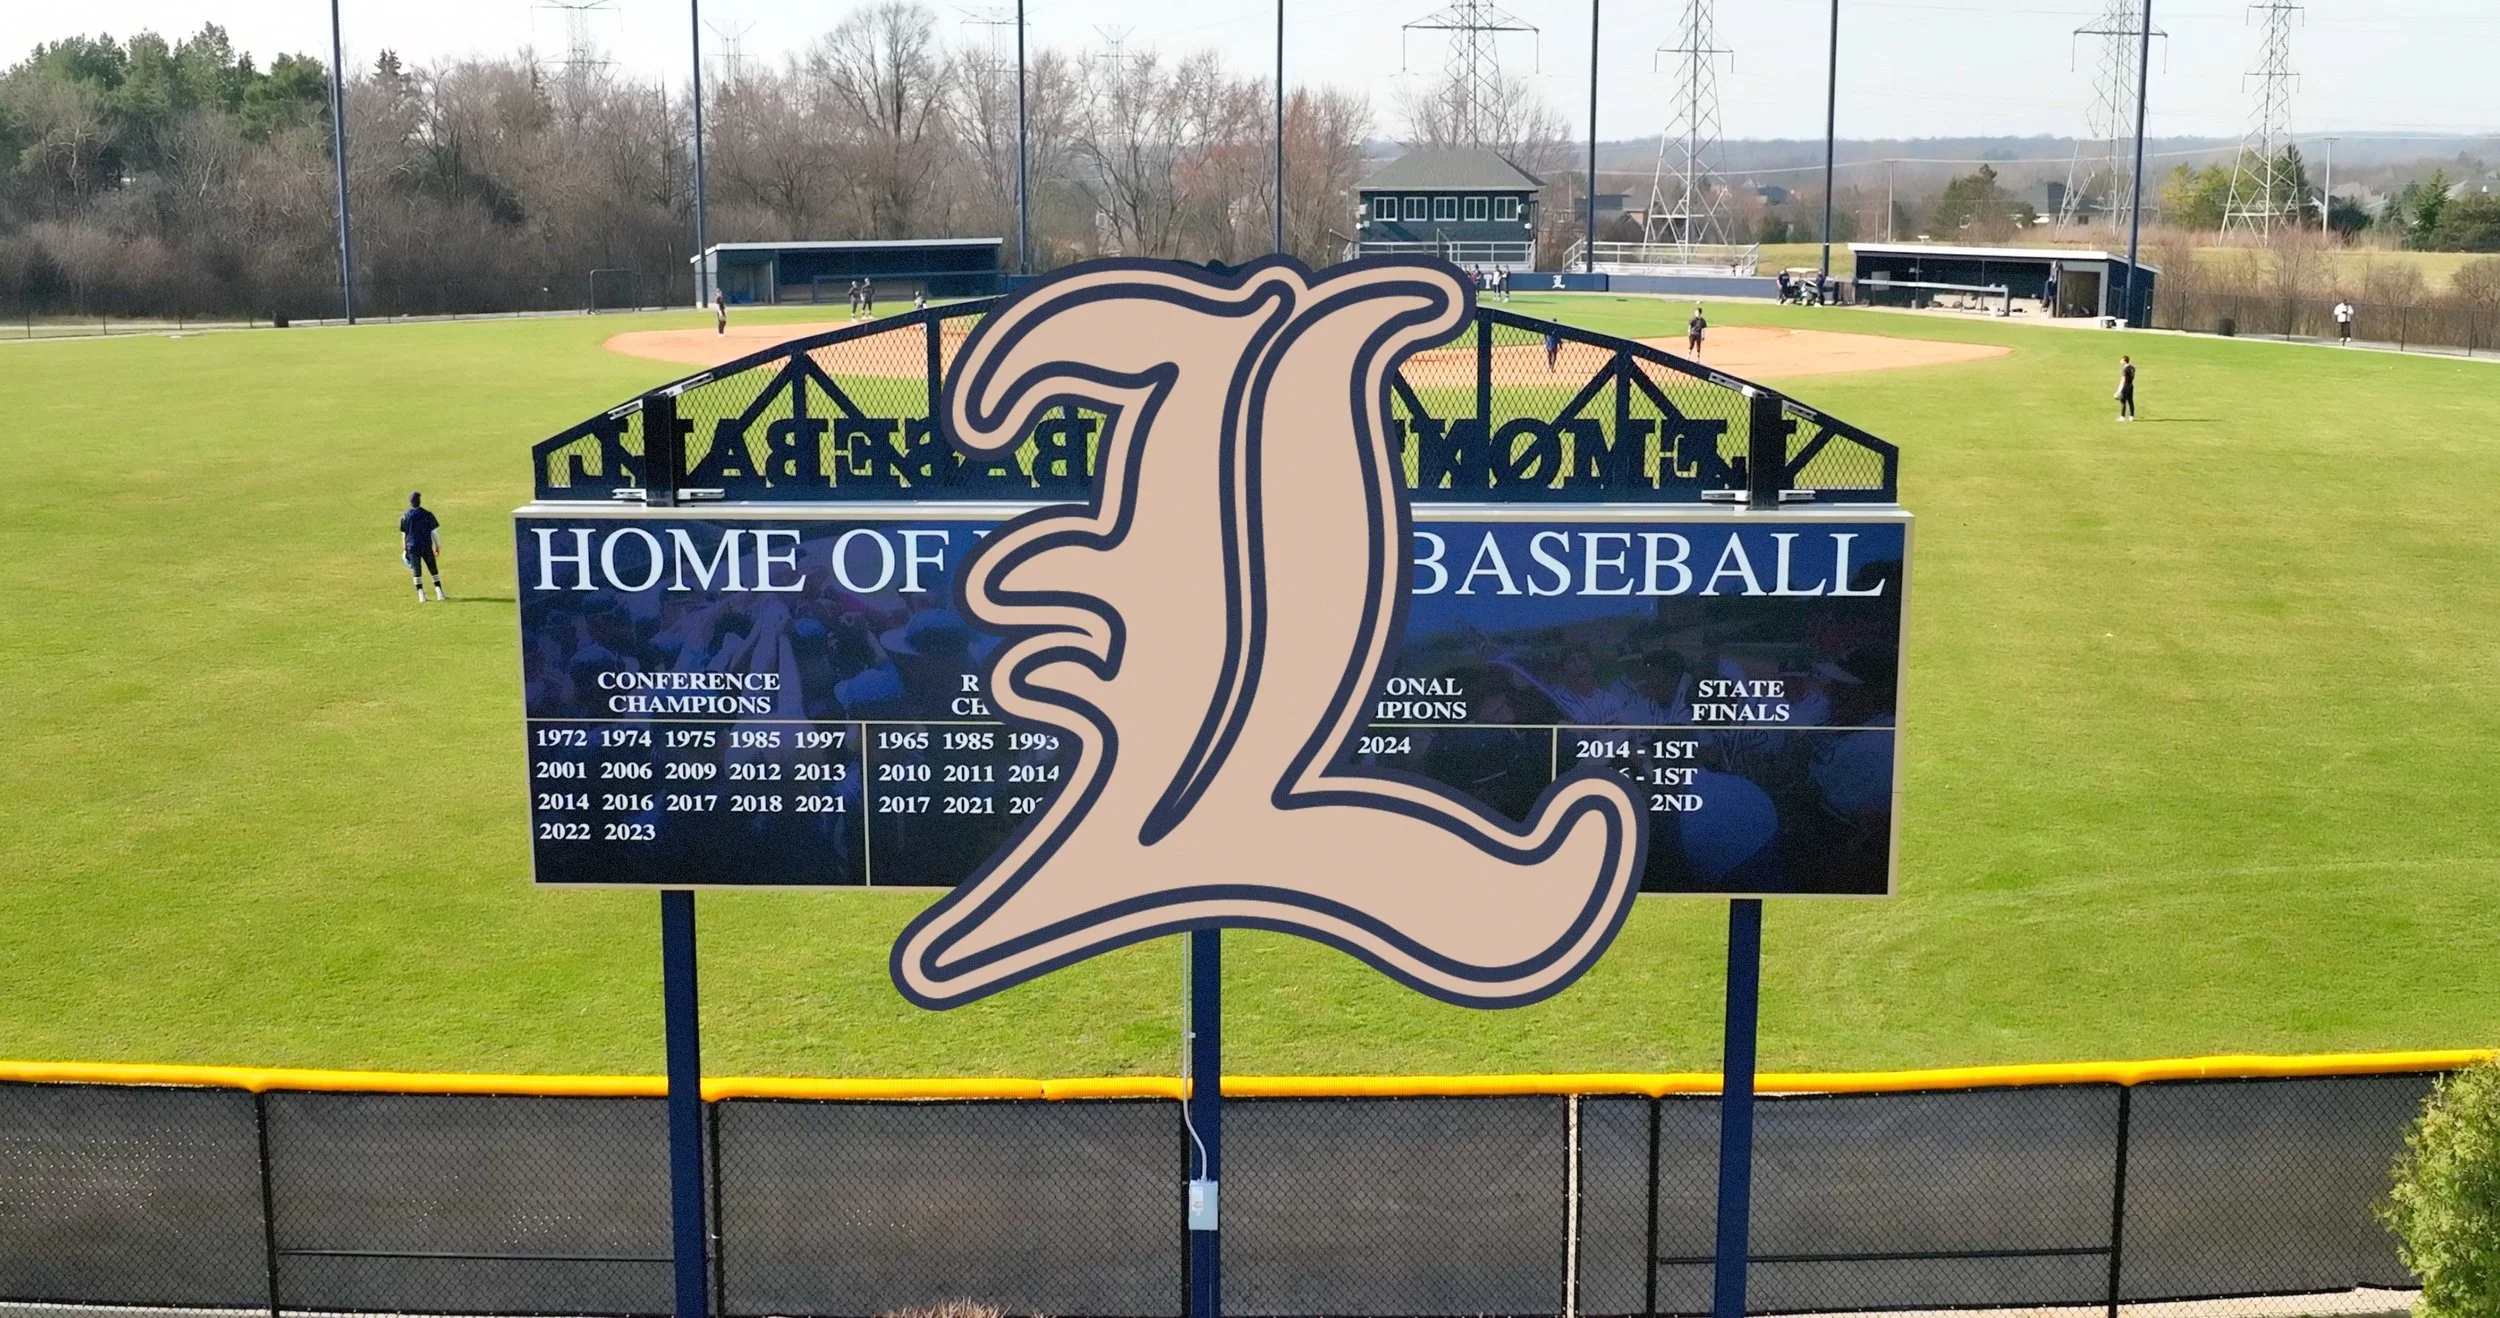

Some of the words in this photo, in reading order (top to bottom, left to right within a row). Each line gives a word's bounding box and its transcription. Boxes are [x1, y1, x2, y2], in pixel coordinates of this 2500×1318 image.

[530, 527, 807, 592] HOME
[832, 528, 950, 593] OF
[598, 671, 781, 691] CONFERENCE
[1383, 677, 1463, 696] ONAL
[1698, 679, 1785, 698] STATE
[608, 695, 771, 714] CHAMPIONS
[1690, 703, 1790, 722] FINALS
[536, 729, 588, 747] 1972
[601, 729, 653, 747] 1974
[665, 730, 716, 748] 1975
[729, 730, 781, 749] 1985
[794, 731, 846, 749] 1997
[878, 731, 929, 750] 1965
[943, 732, 994, 750] 1985
[1357, 736, 1412, 754] 2024
[1575, 740, 1631, 758] 2014
[1653, 740, 1699, 759] 1ST
[536, 761, 587, 779] 2001
[600, 761, 653, 780] 2006
[665, 762, 717, 780] 2009
[729, 763, 782, 781] 2012
[794, 763, 846, 781] 2013
[878, 764, 931, 782] 2010
[943, 764, 995, 783] 2011
[1008, 765, 1060, 783] 2014
[1652, 767, 1698, 786] 1ST
[538, 793, 590, 810] 2014
[602, 793, 654, 811] 2016
[666, 794, 718, 812] 2017
[730, 794, 783, 813] 2018
[795, 795, 846, 813] 2021
[878, 795, 931, 813] 2017
[943, 796, 995, 814] 2021
[1009, 796, 1043, 815] 20
[1650, 793, 1704, 812] 2ND
[539, 823, 591, 840] 2022
[604, 823, 656, 841] 2023
